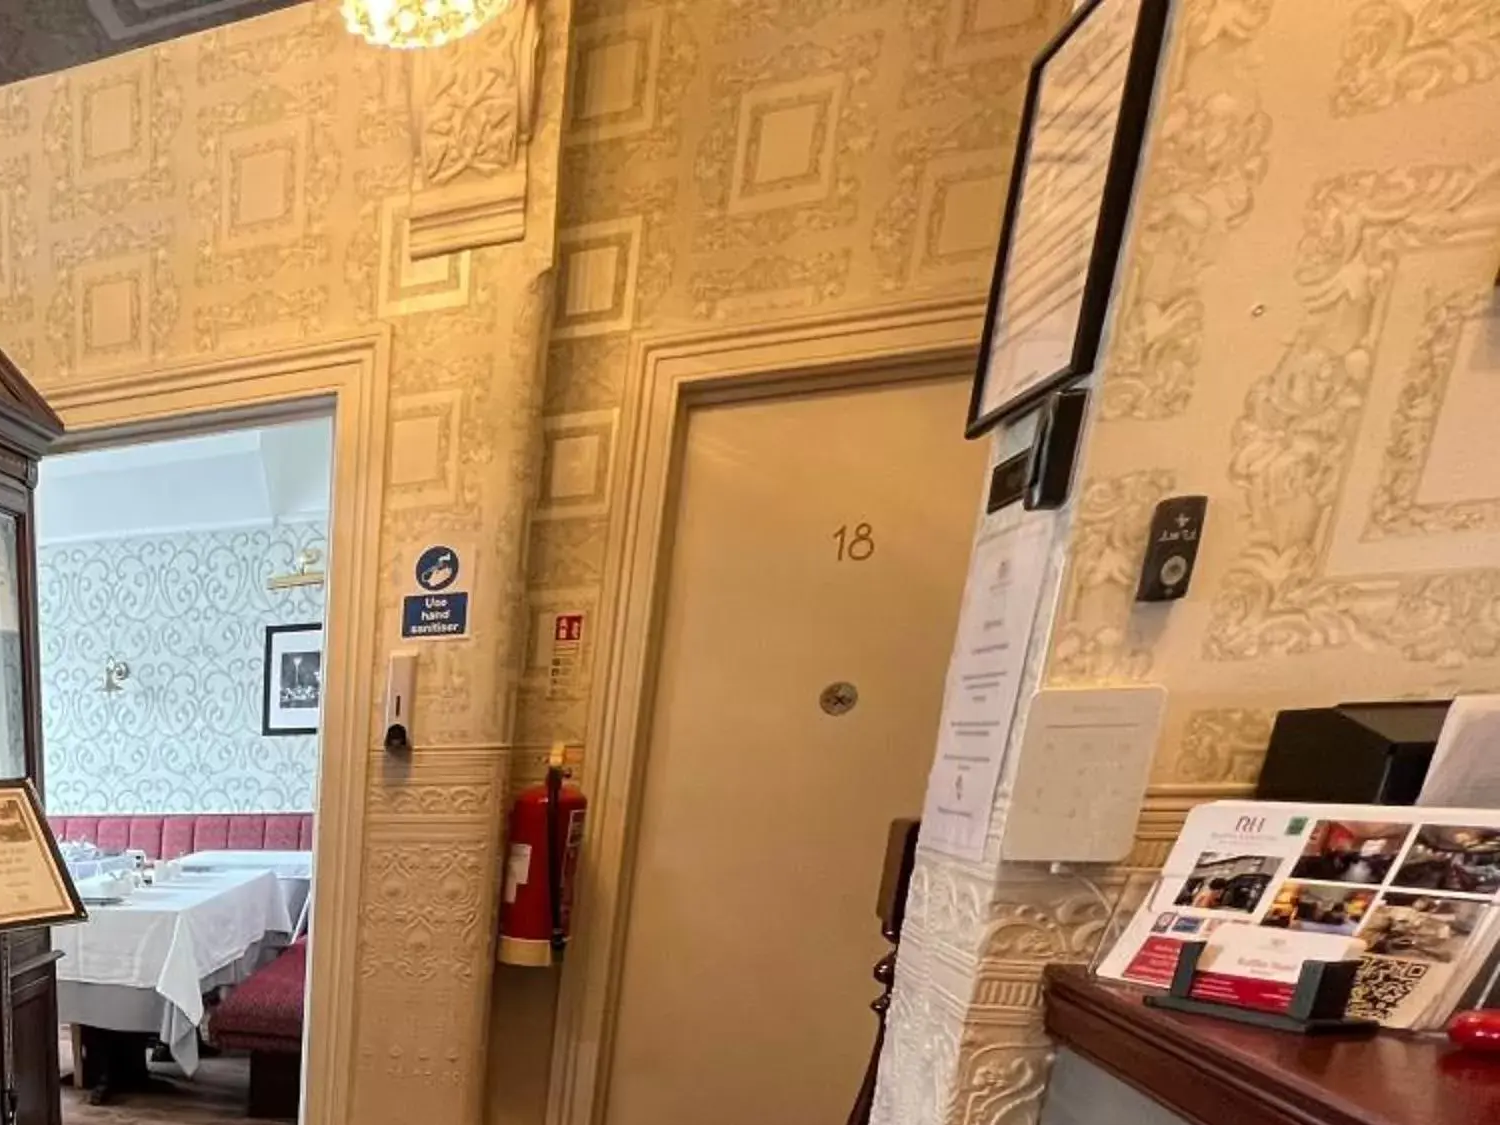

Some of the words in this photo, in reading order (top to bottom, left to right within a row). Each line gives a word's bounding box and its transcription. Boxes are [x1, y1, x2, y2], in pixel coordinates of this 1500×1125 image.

[833, 522, 875, 561] 18
[425, 596, 448, 608] Use
[421, 609, 451, 620] hand
[411, 622, 459, 634] sanitiser
